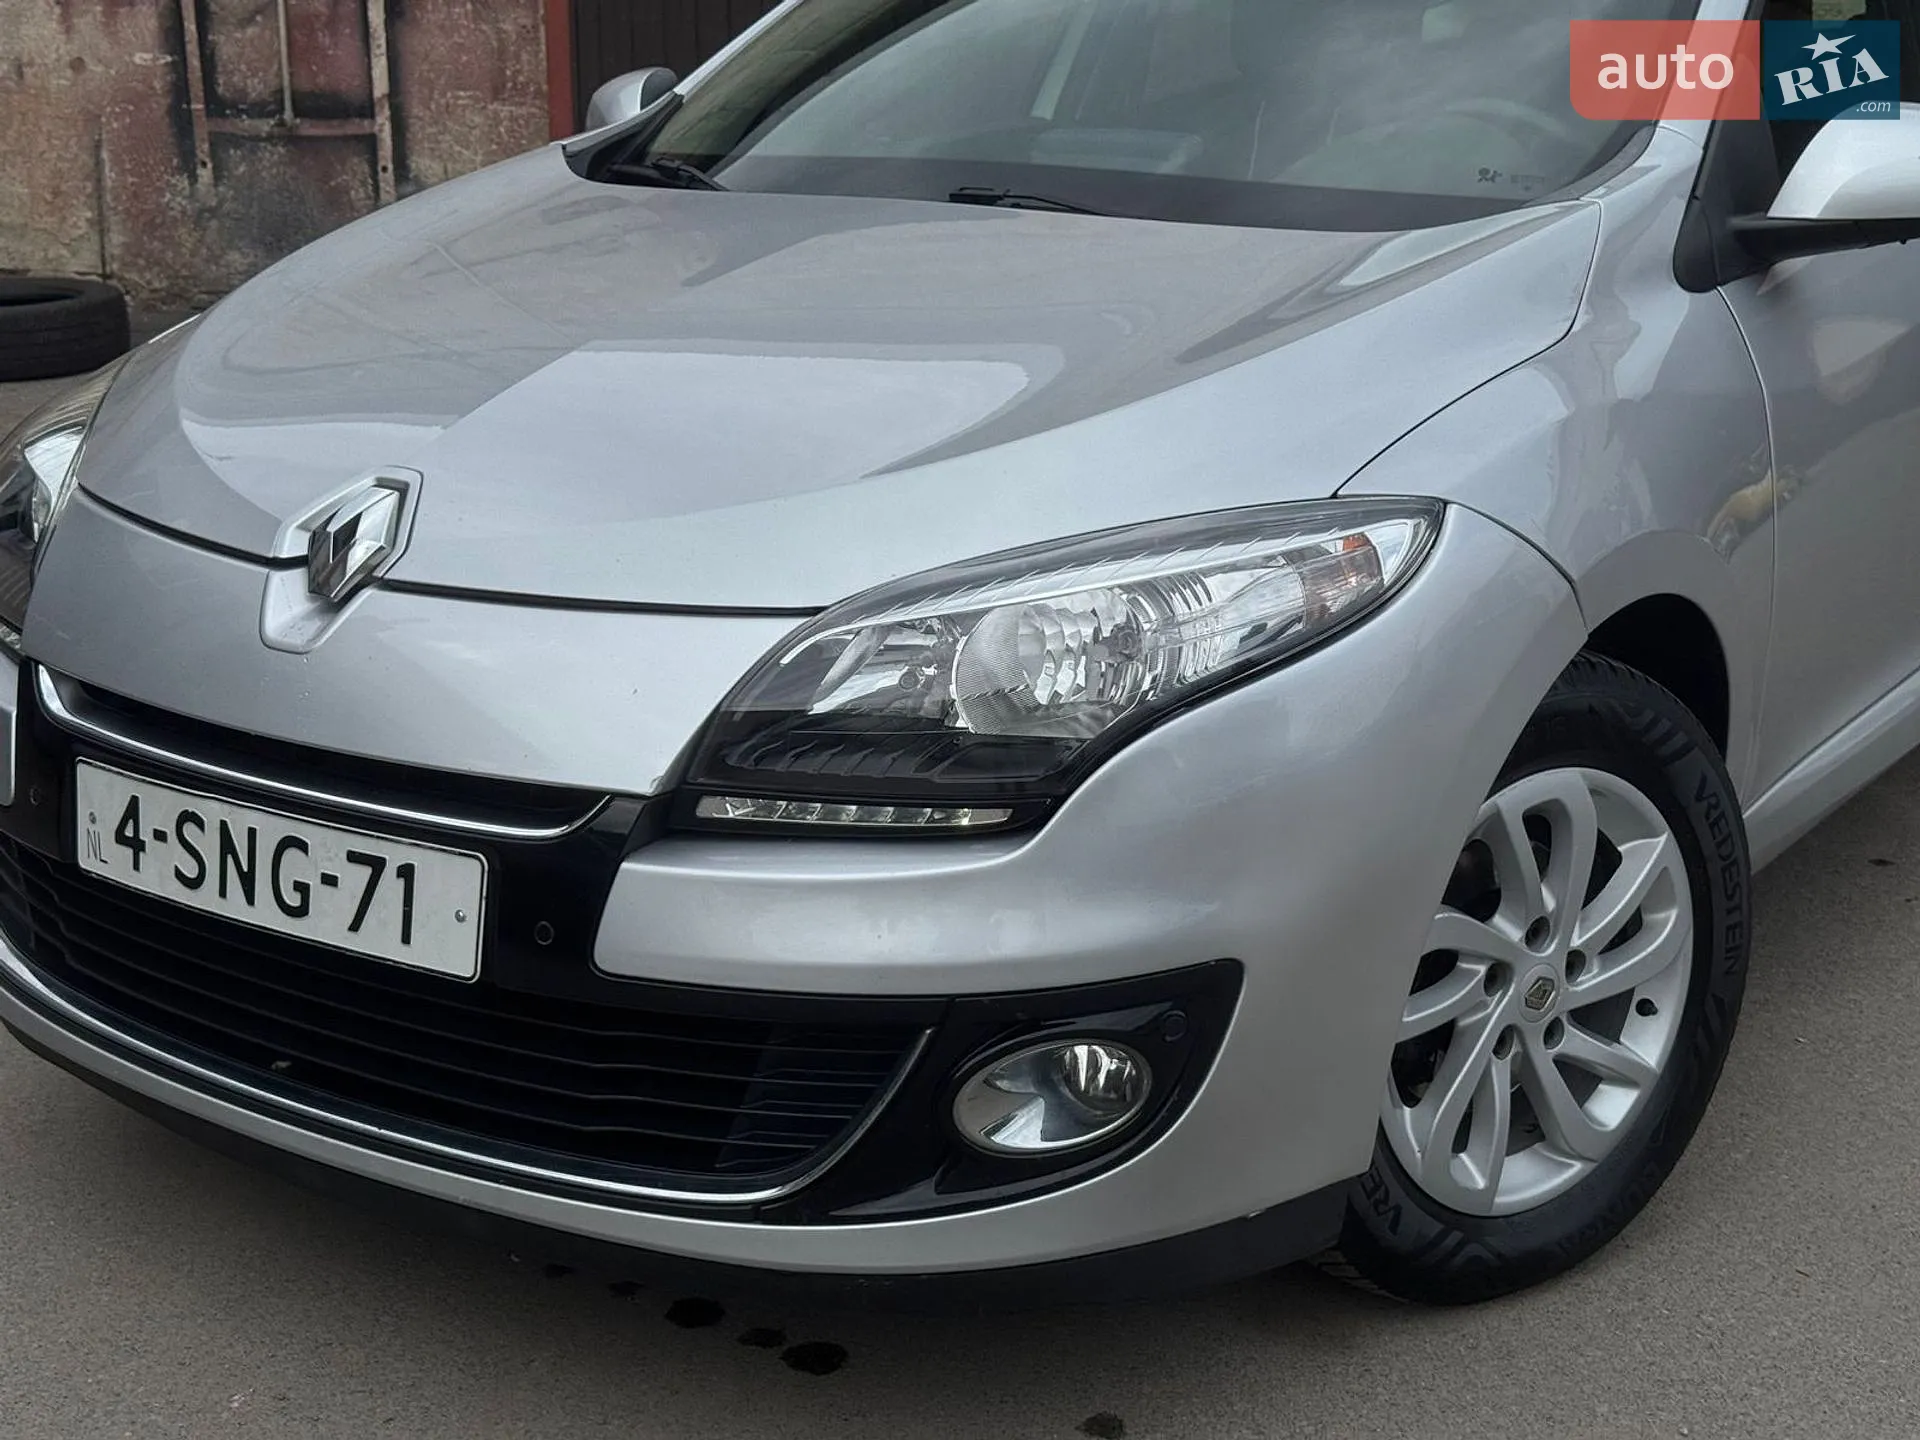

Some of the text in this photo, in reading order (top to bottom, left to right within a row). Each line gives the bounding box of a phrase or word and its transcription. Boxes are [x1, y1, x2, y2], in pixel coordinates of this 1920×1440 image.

[86, 827, 109, 865] NL
[114, 794, 416, 946] 4-SNG-71
[1694, 773, 1744, 977] VREDESTEIN
